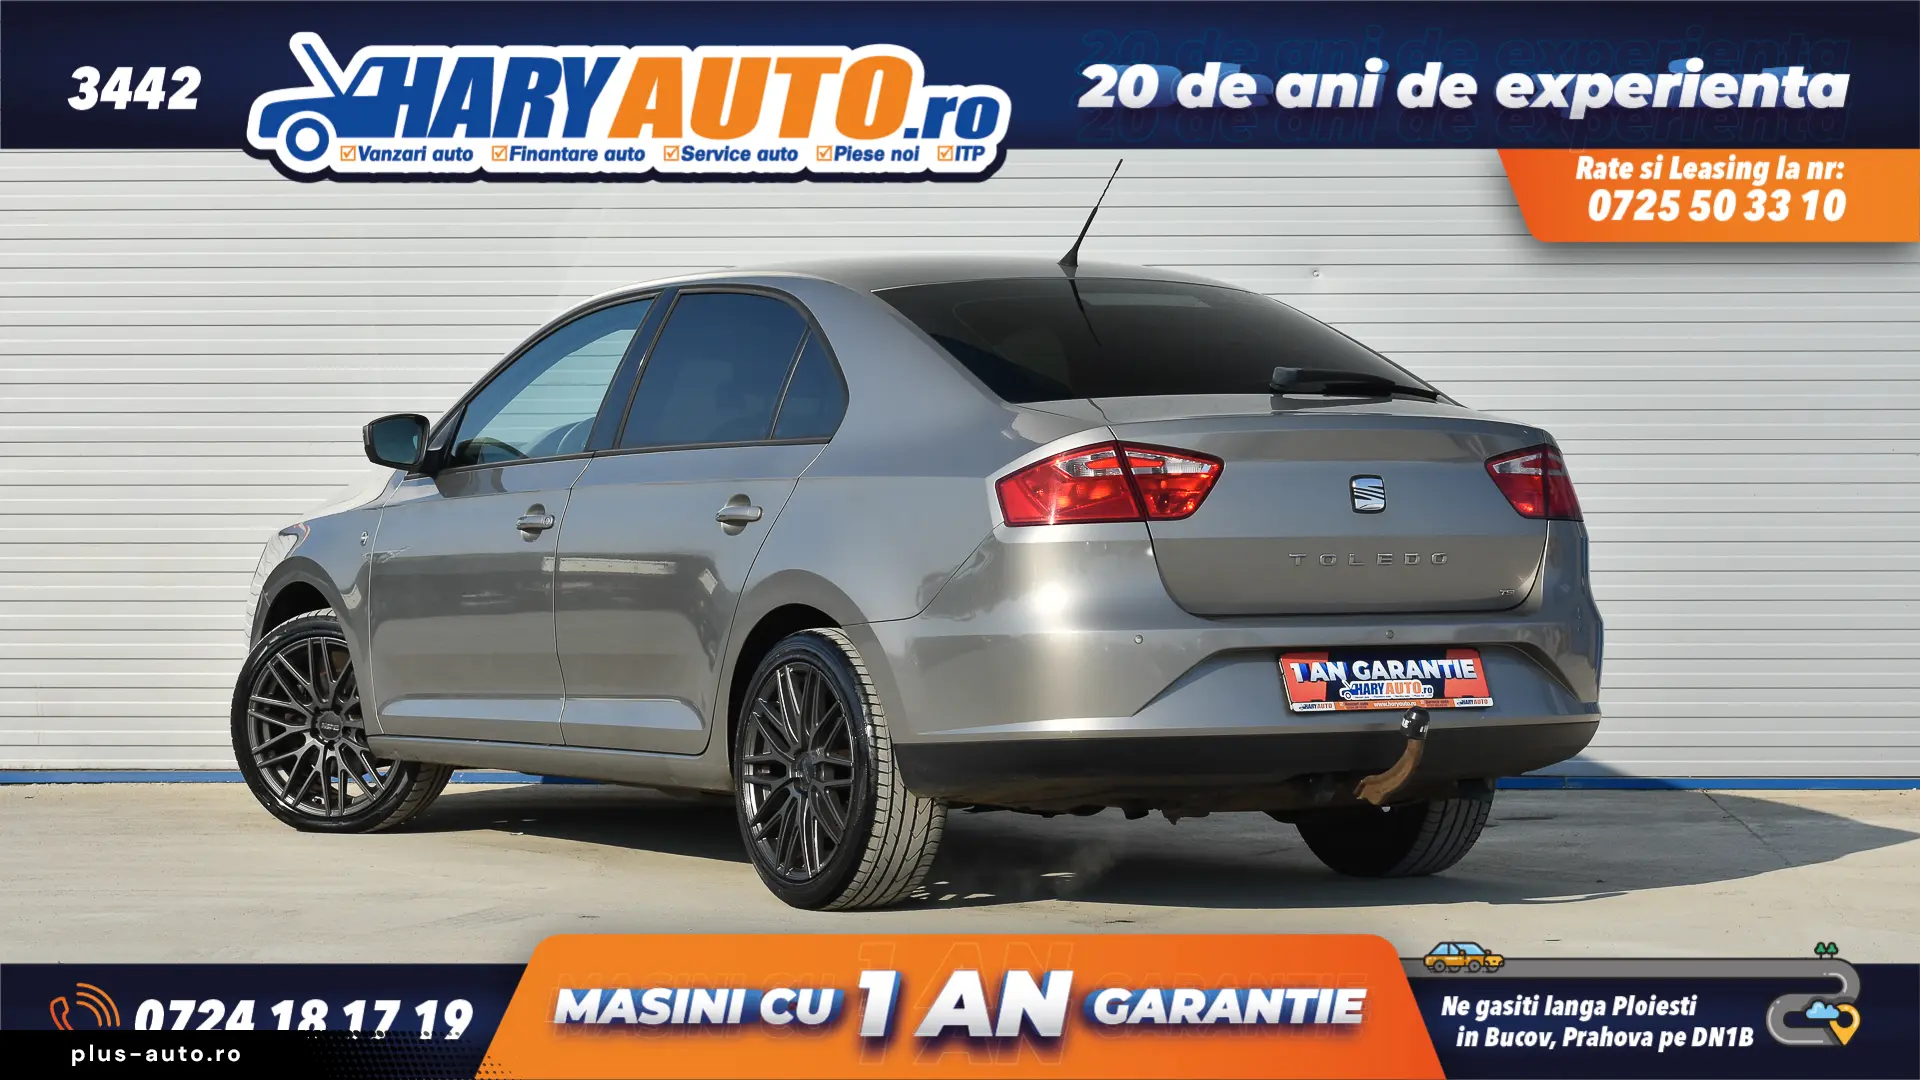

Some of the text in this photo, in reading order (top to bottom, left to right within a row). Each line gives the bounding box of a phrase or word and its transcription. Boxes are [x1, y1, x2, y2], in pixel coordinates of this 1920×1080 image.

[1289, 552, 1448, 567] TOLEDO
[1289, 658, 1478, 684] 1 AN GARANTIE
[1355, 681, 1433, 696] HARYAUTO.ro
